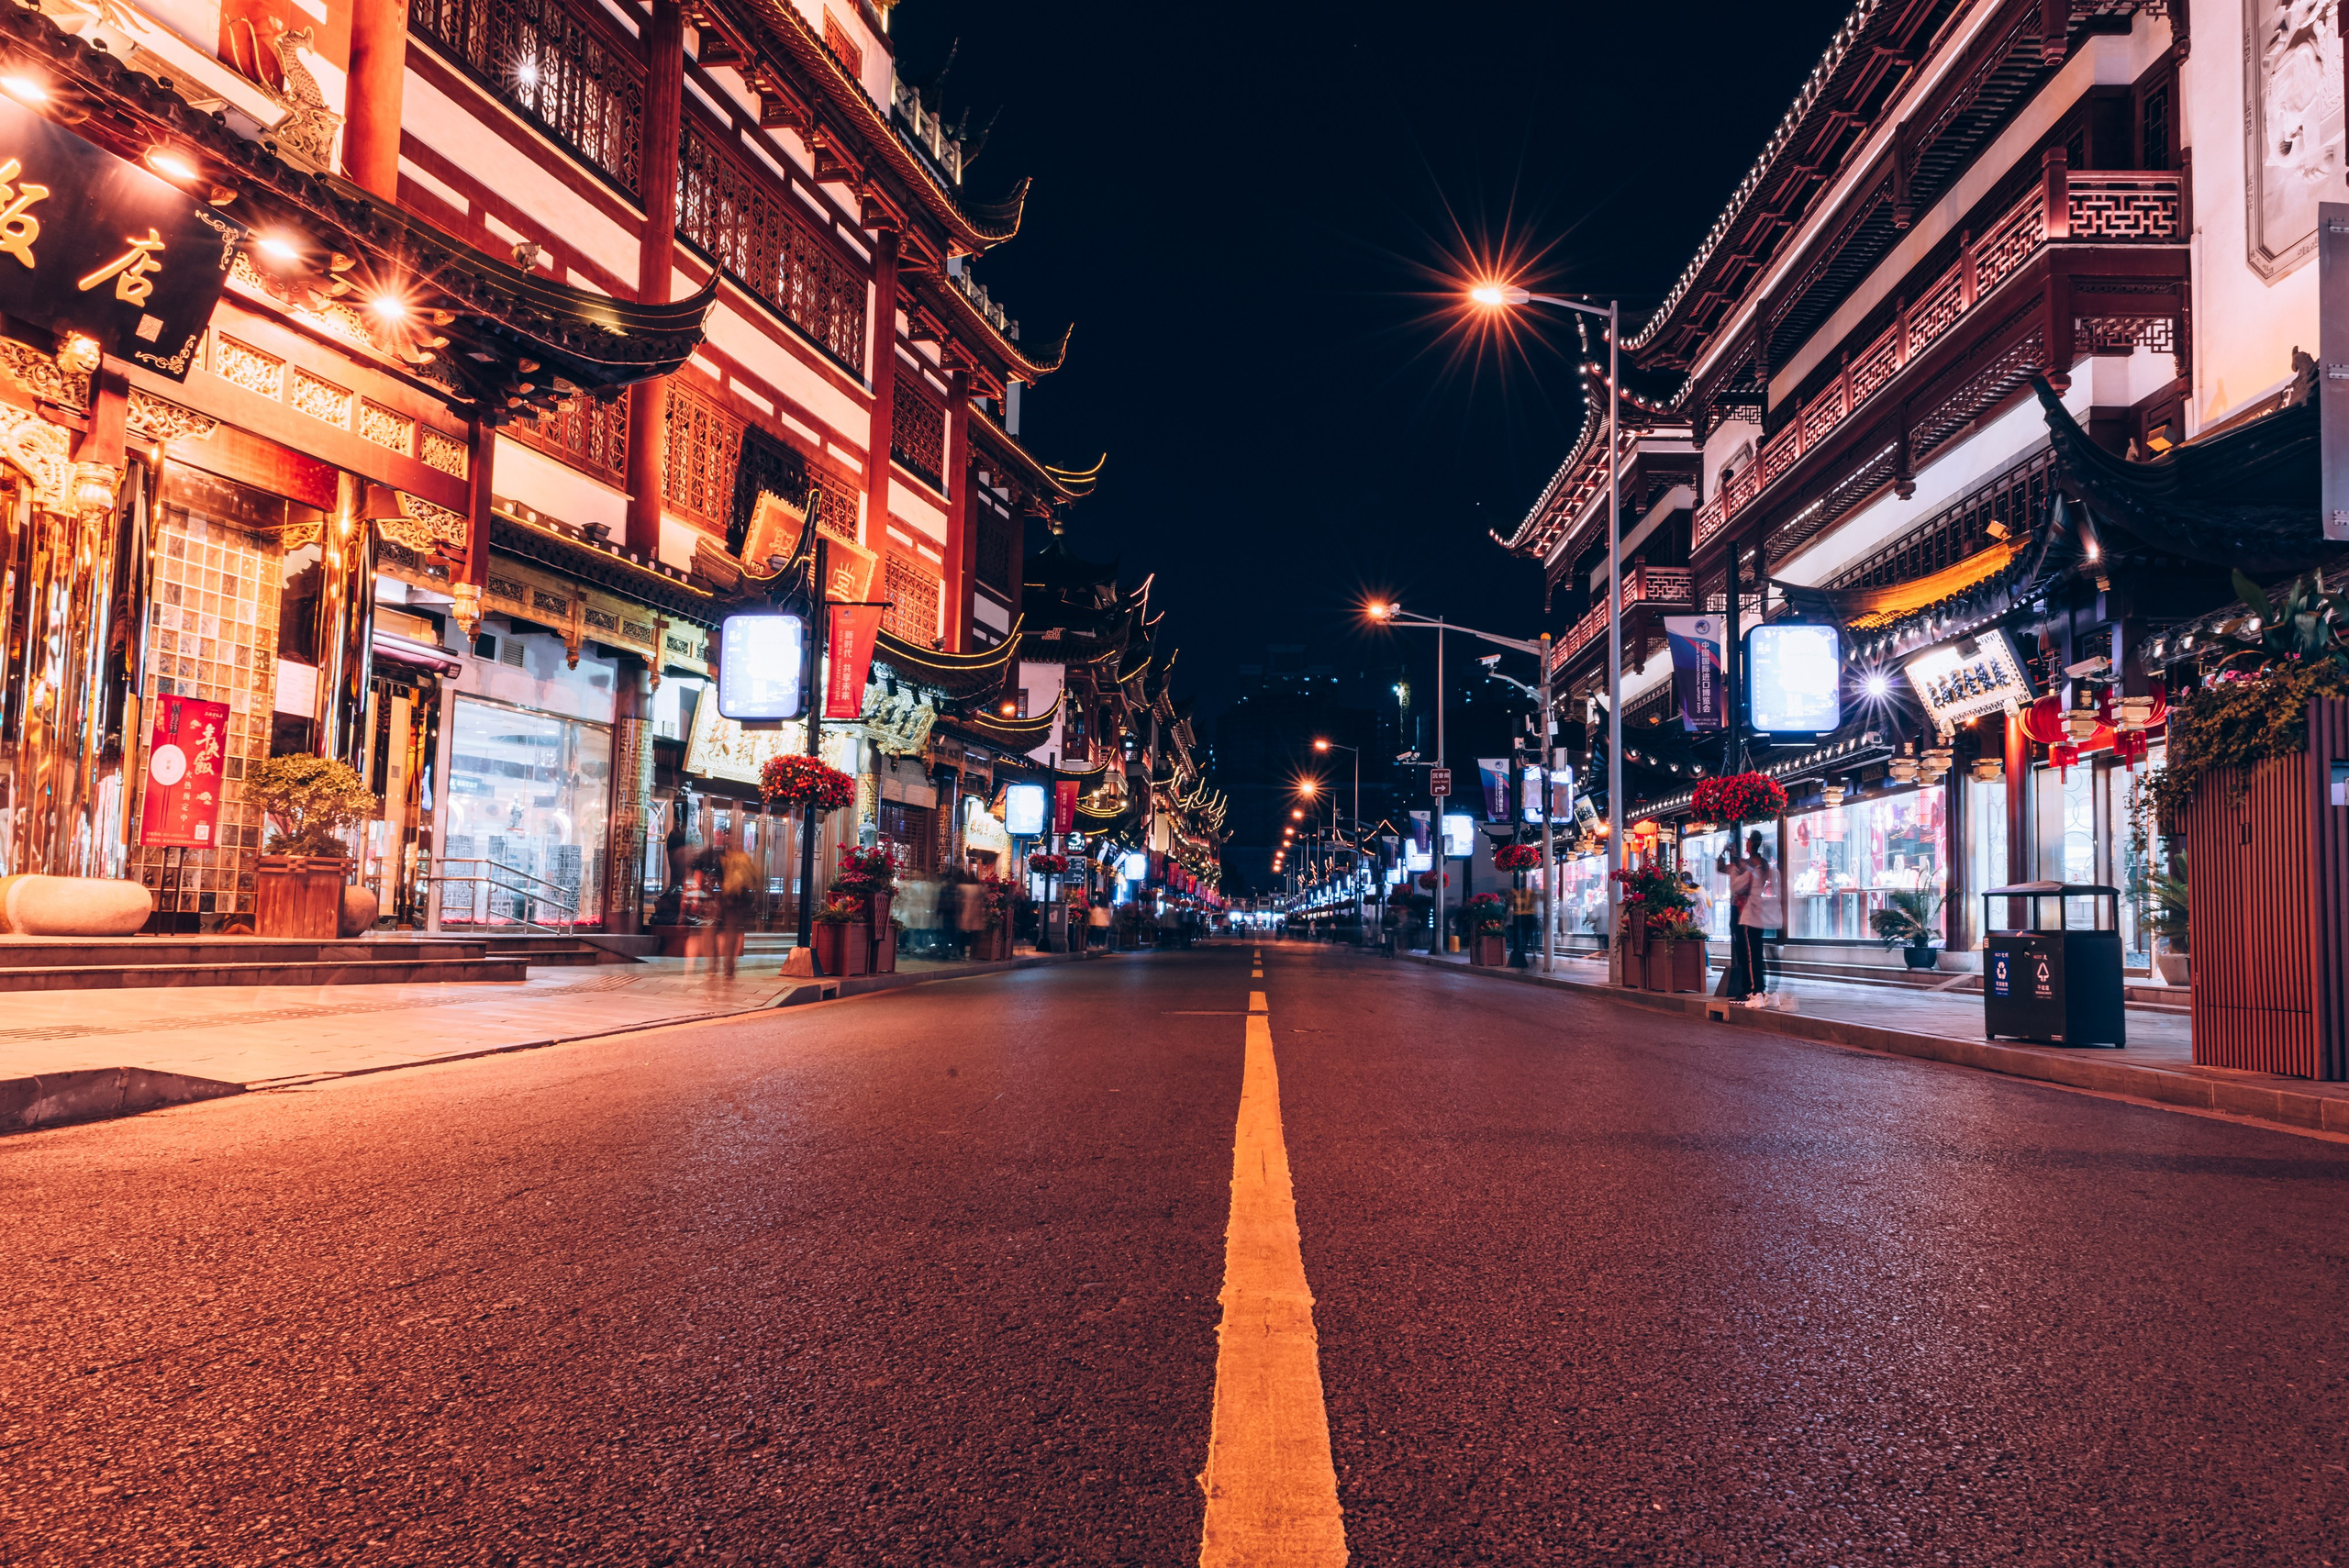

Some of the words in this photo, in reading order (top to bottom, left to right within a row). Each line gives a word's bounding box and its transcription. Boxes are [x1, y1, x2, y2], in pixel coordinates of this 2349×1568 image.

[767, 526, 856, 603] 聚堂
[843, 630, 854, 658] 新时代
[841, 663, 852, 701] 共享未来
[1701, 641, 1711, 713] 中国国际进口博览会
